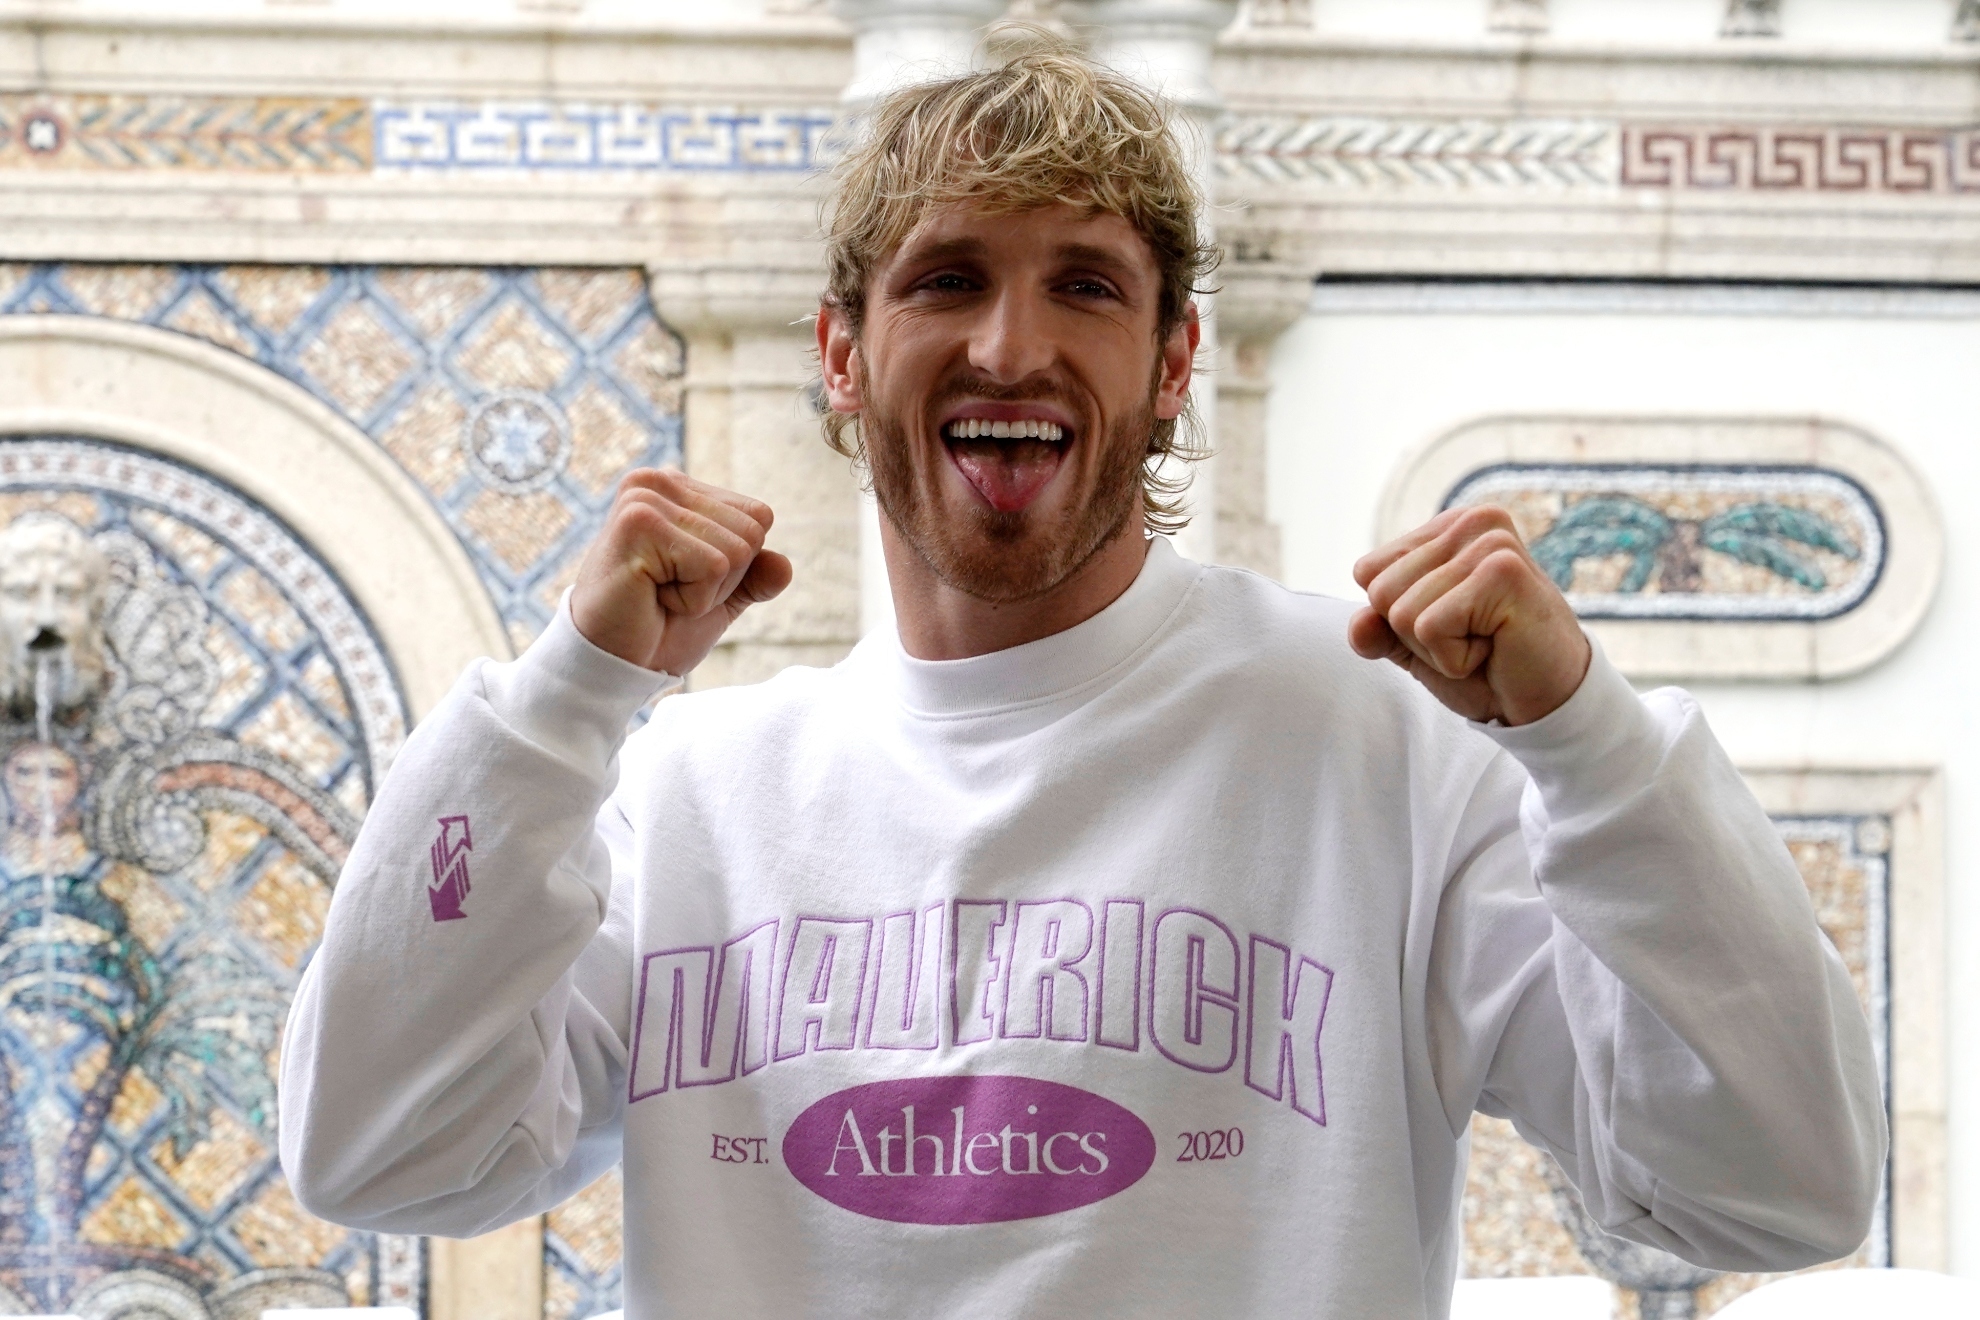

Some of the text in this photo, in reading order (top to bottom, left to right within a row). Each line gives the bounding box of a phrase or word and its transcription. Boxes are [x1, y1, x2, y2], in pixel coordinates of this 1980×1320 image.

[628, 898, 1335, 1128] MAVERICK
[710, 1103, 1245, 1178] EST. Athletics 2020
